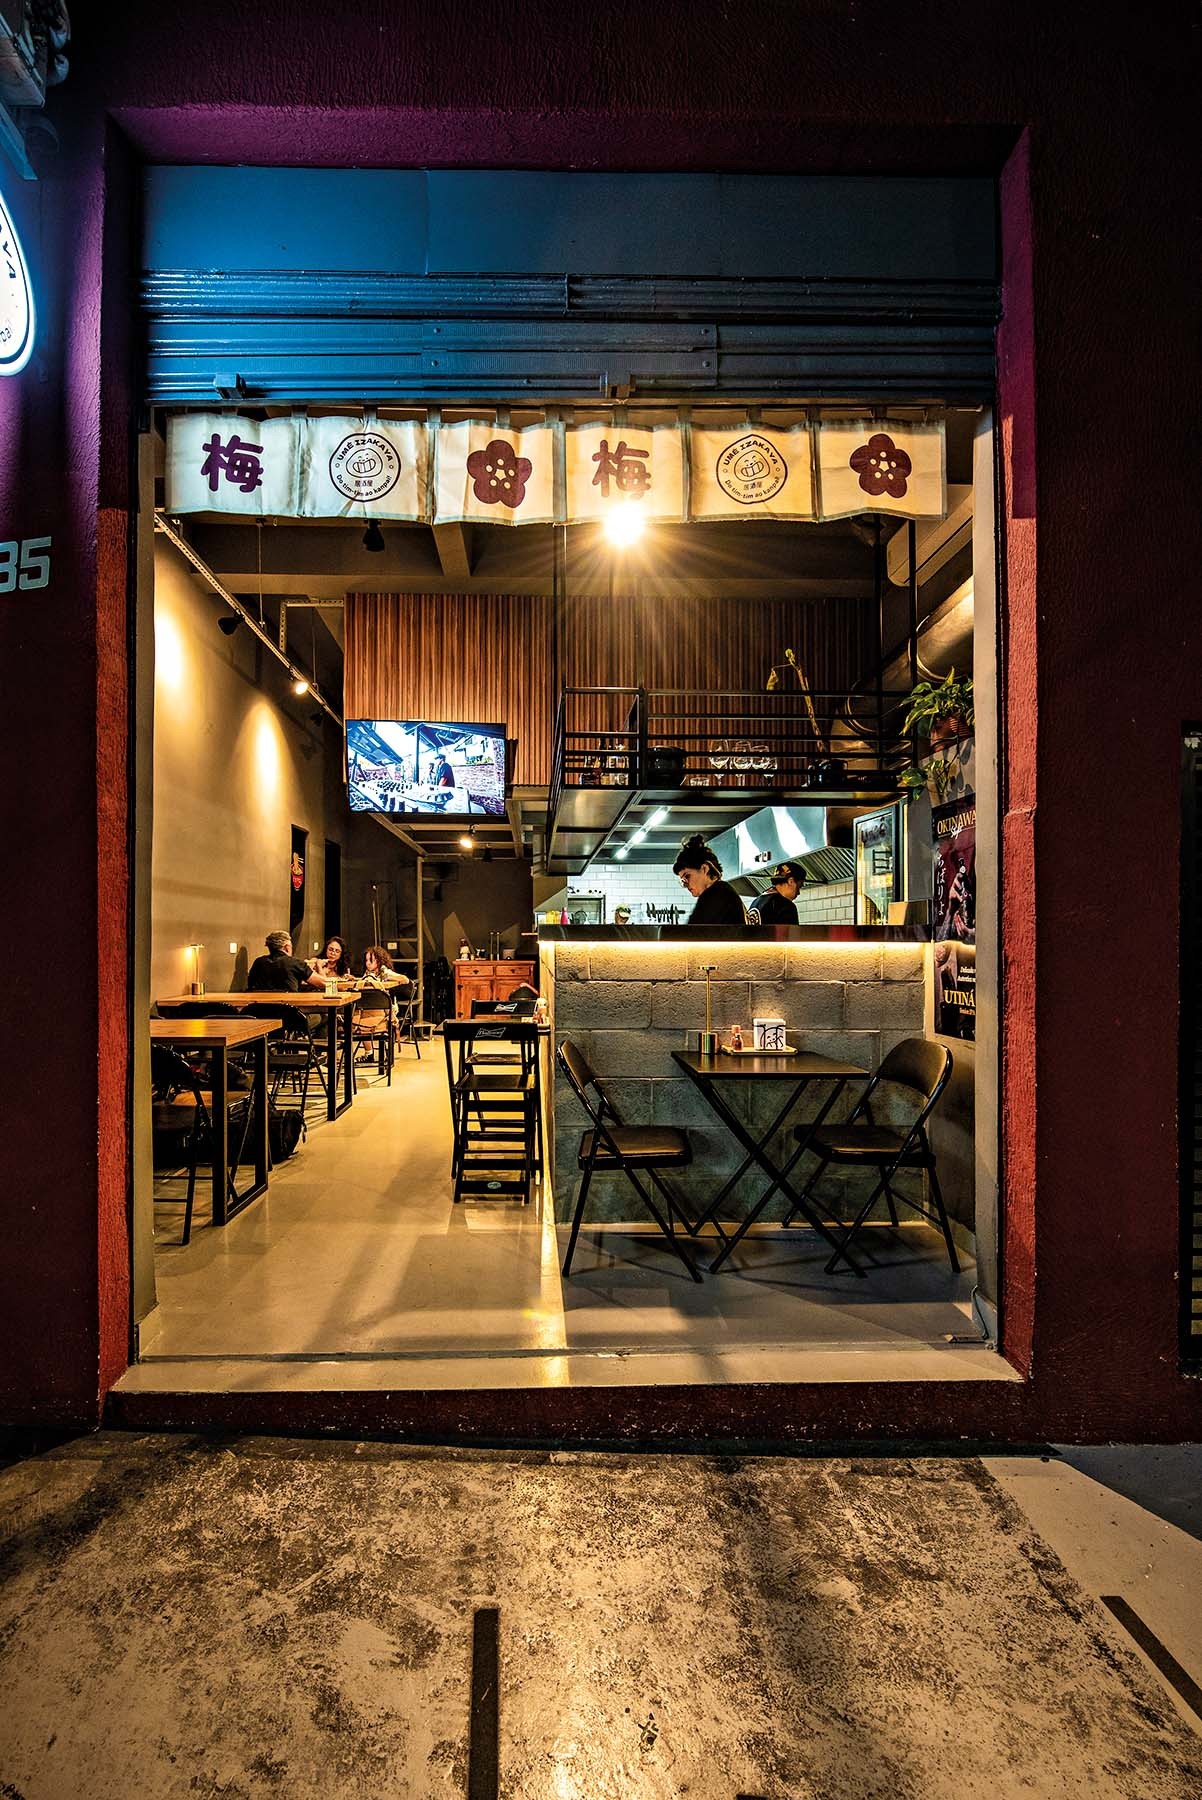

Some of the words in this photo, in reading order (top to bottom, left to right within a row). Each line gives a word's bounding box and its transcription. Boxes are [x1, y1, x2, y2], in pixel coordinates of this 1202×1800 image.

[355, 438, 393, 461] IZAKAYA
[740, 440, 778, 464] IZAKAYA
[201, 433, 264, 493] 梅
[592, 440, 651, 499] 梅
[937, 810, 976, 834] OKINAWA
